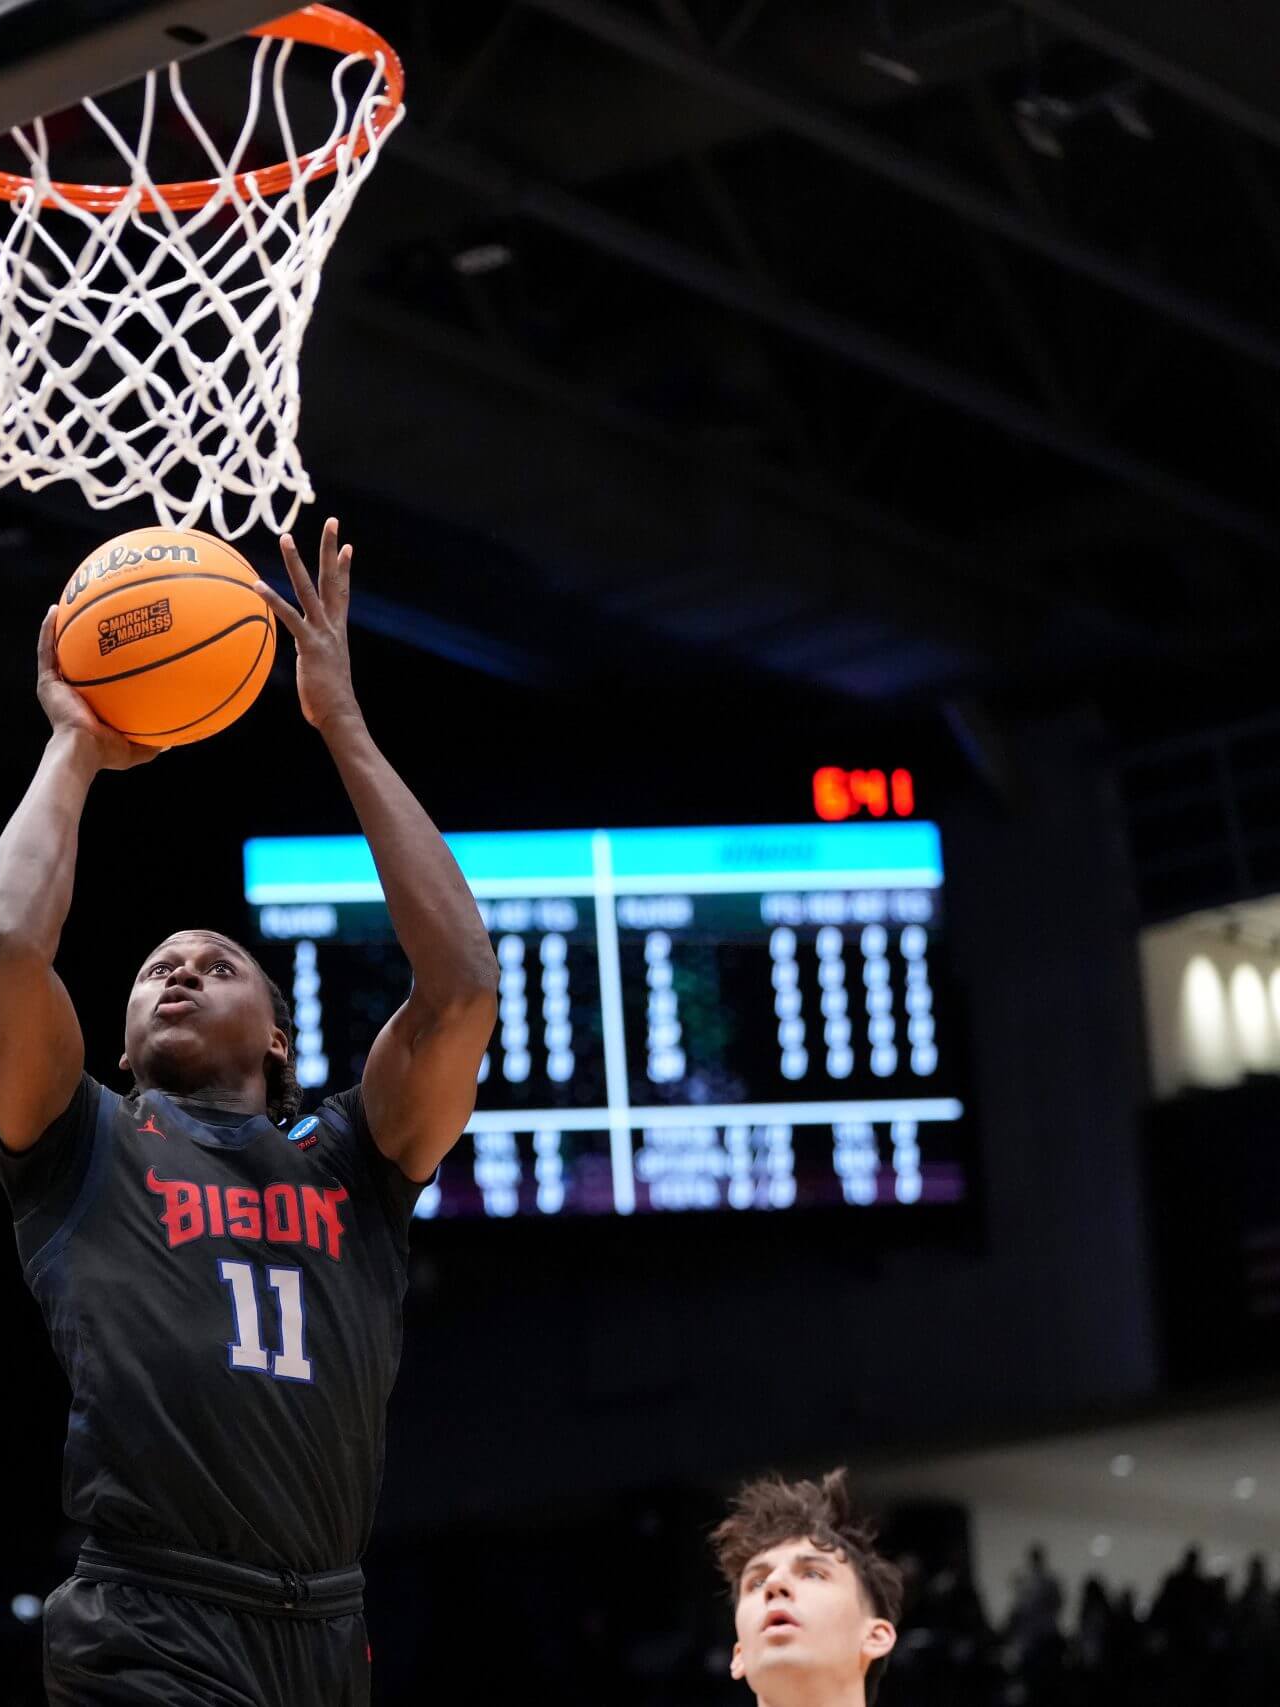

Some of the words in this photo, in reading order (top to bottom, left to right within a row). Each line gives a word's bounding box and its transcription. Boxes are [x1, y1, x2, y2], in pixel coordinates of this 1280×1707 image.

[65, 545, 199, 605] Wilson
[109, 607, 149, 631] MARCH
[117, 614, 172, 641] MADNESS
[146, 1166, 349, 1261] BISON
[219, 1259, 313, 1382] 11
